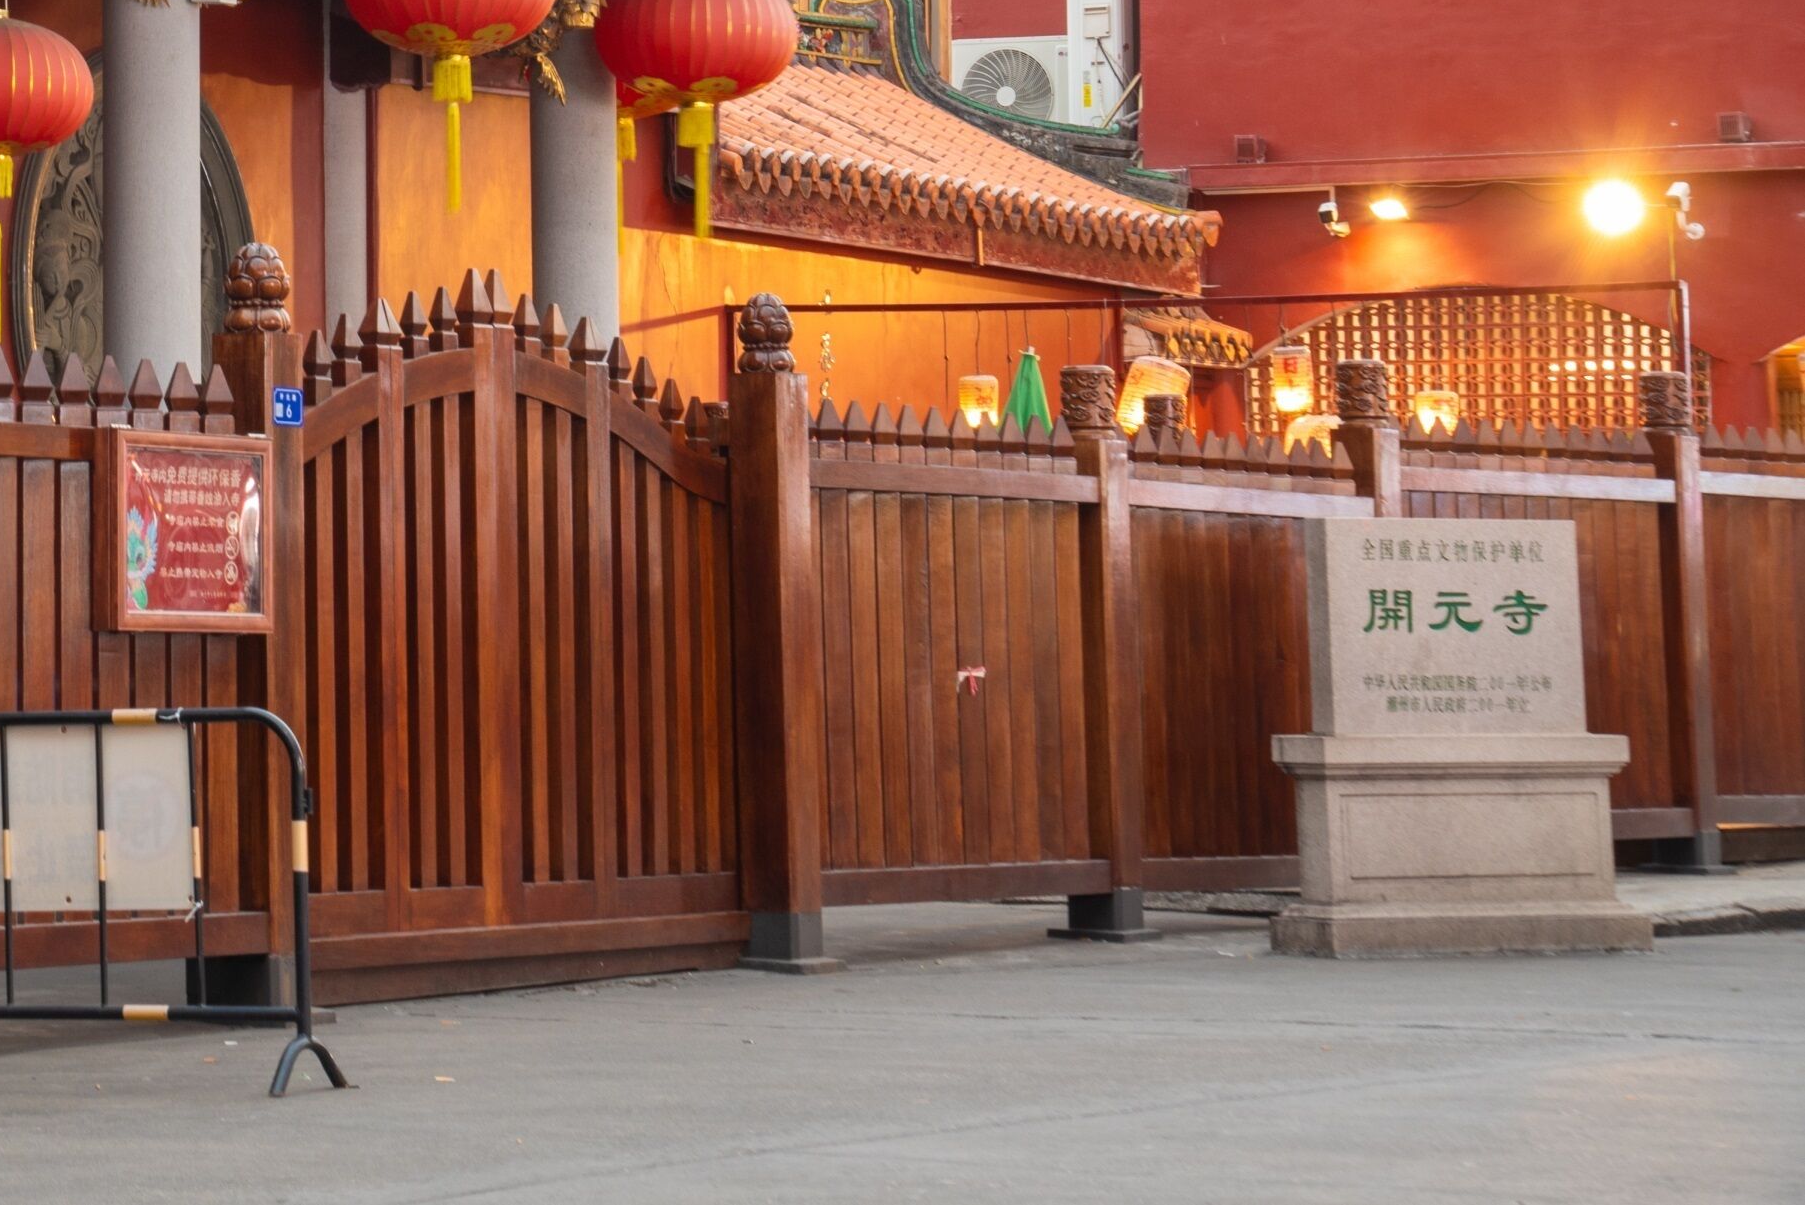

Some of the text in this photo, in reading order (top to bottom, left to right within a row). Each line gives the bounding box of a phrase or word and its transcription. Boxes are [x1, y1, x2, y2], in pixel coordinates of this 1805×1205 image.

[1362, 538, 1545, 563] 全国重点文物保护单位
[1362, 588, 1548, 635] 開元寺
